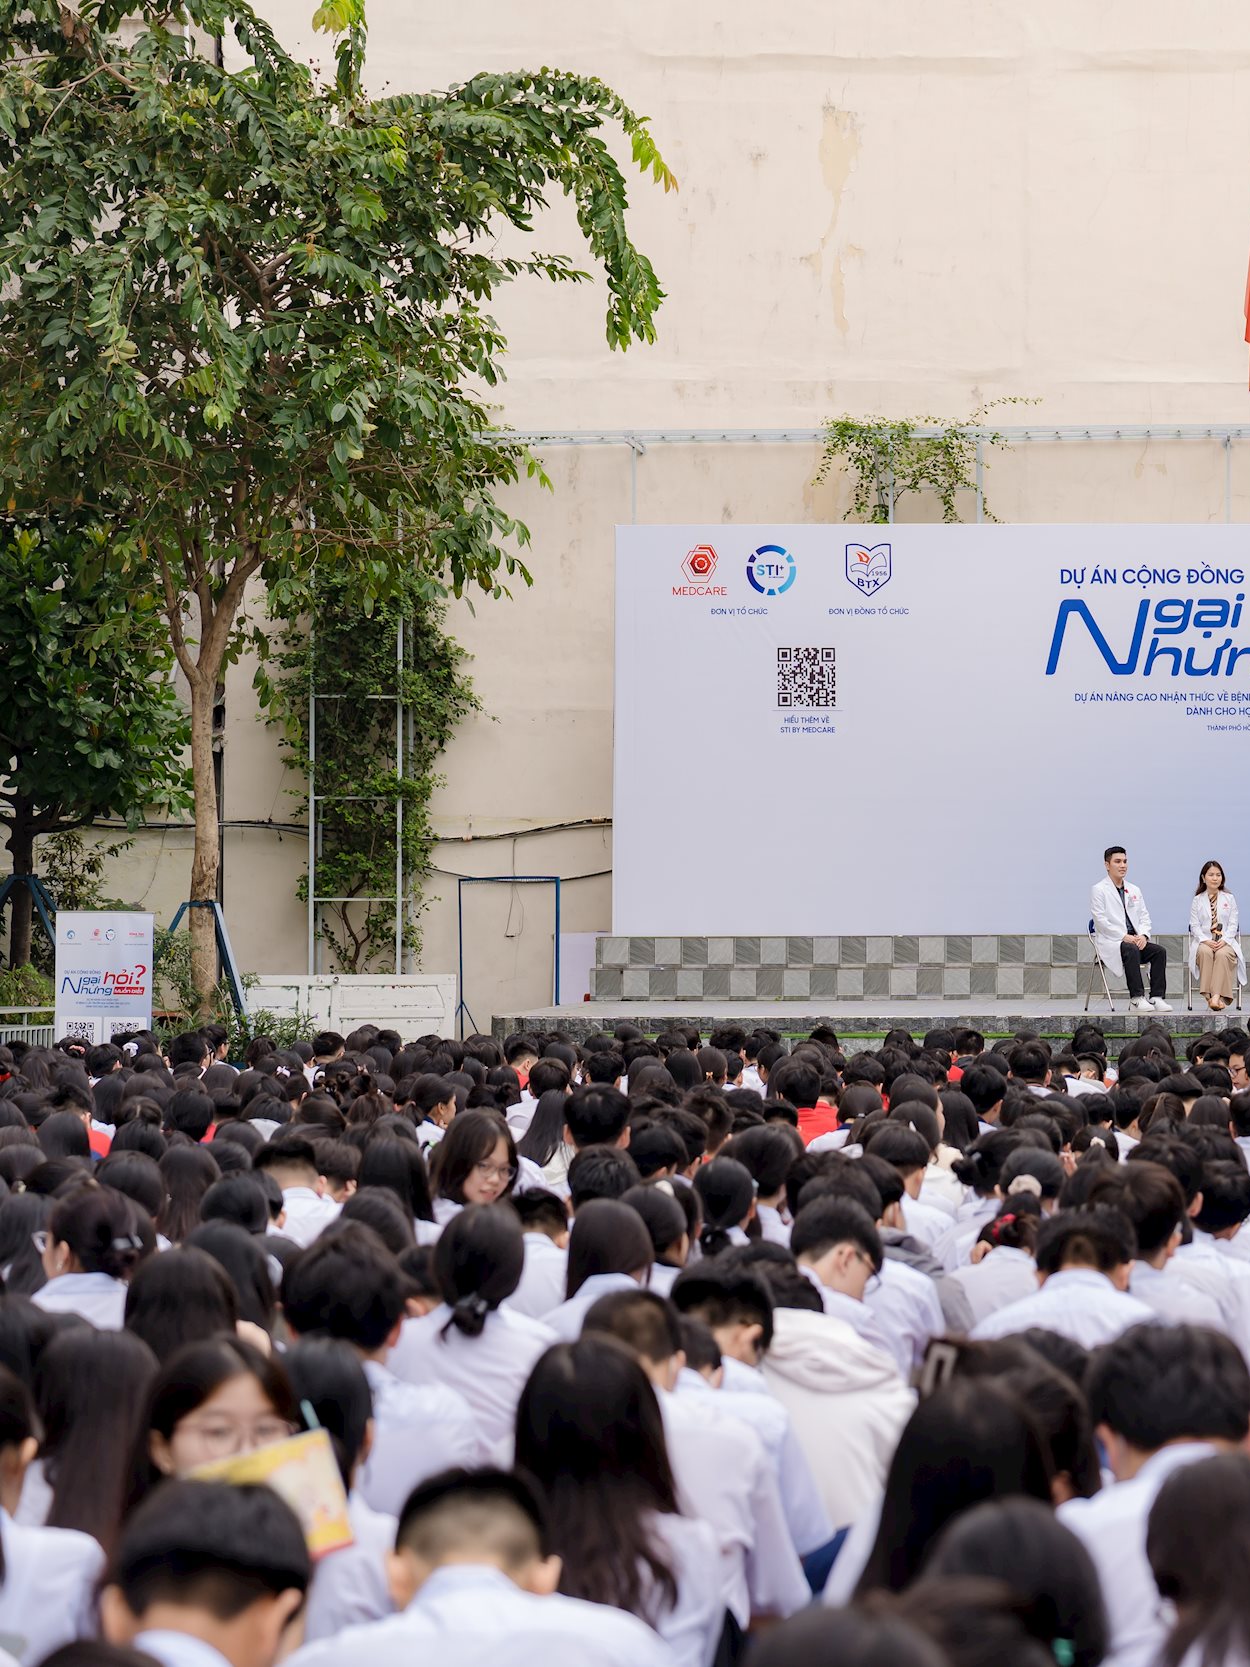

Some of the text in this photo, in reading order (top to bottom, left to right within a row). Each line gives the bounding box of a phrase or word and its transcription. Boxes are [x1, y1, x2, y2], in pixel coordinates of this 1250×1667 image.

[1060, 560, 1245, 590] DỰ ÁN CỘNG ĐỒNG
[857, 577, 880, 589] BTX
[672, 585, 728, 597] MEDCARE
[710, 605, 768, 617] ĐƠN VỊ TỔ CHỨC
[828, 605, 910, 617] ĐƠN VỊ ĐỒNG TỔ CHỨC
[1074, 691, 1089, 703] DỰ
[1089, 690, 1104, 701] ÁN
[1105, 690, 1135, 701] NÂNG
[1136, 692, 1158, 701] CAO
[1159, 690, 1187, 703] NHẬN
[1188, 691, 1215, 701] THỨC
[1216, 689, 1229, 701] VỀ
[1186, 705, 1213, 716] DÀNH
[1214, 707, 1237, 716] CHO
[783, 714, 831, 724] HIỂU THÊM VỀ
[103, 964, 147, 985] hỏi?
